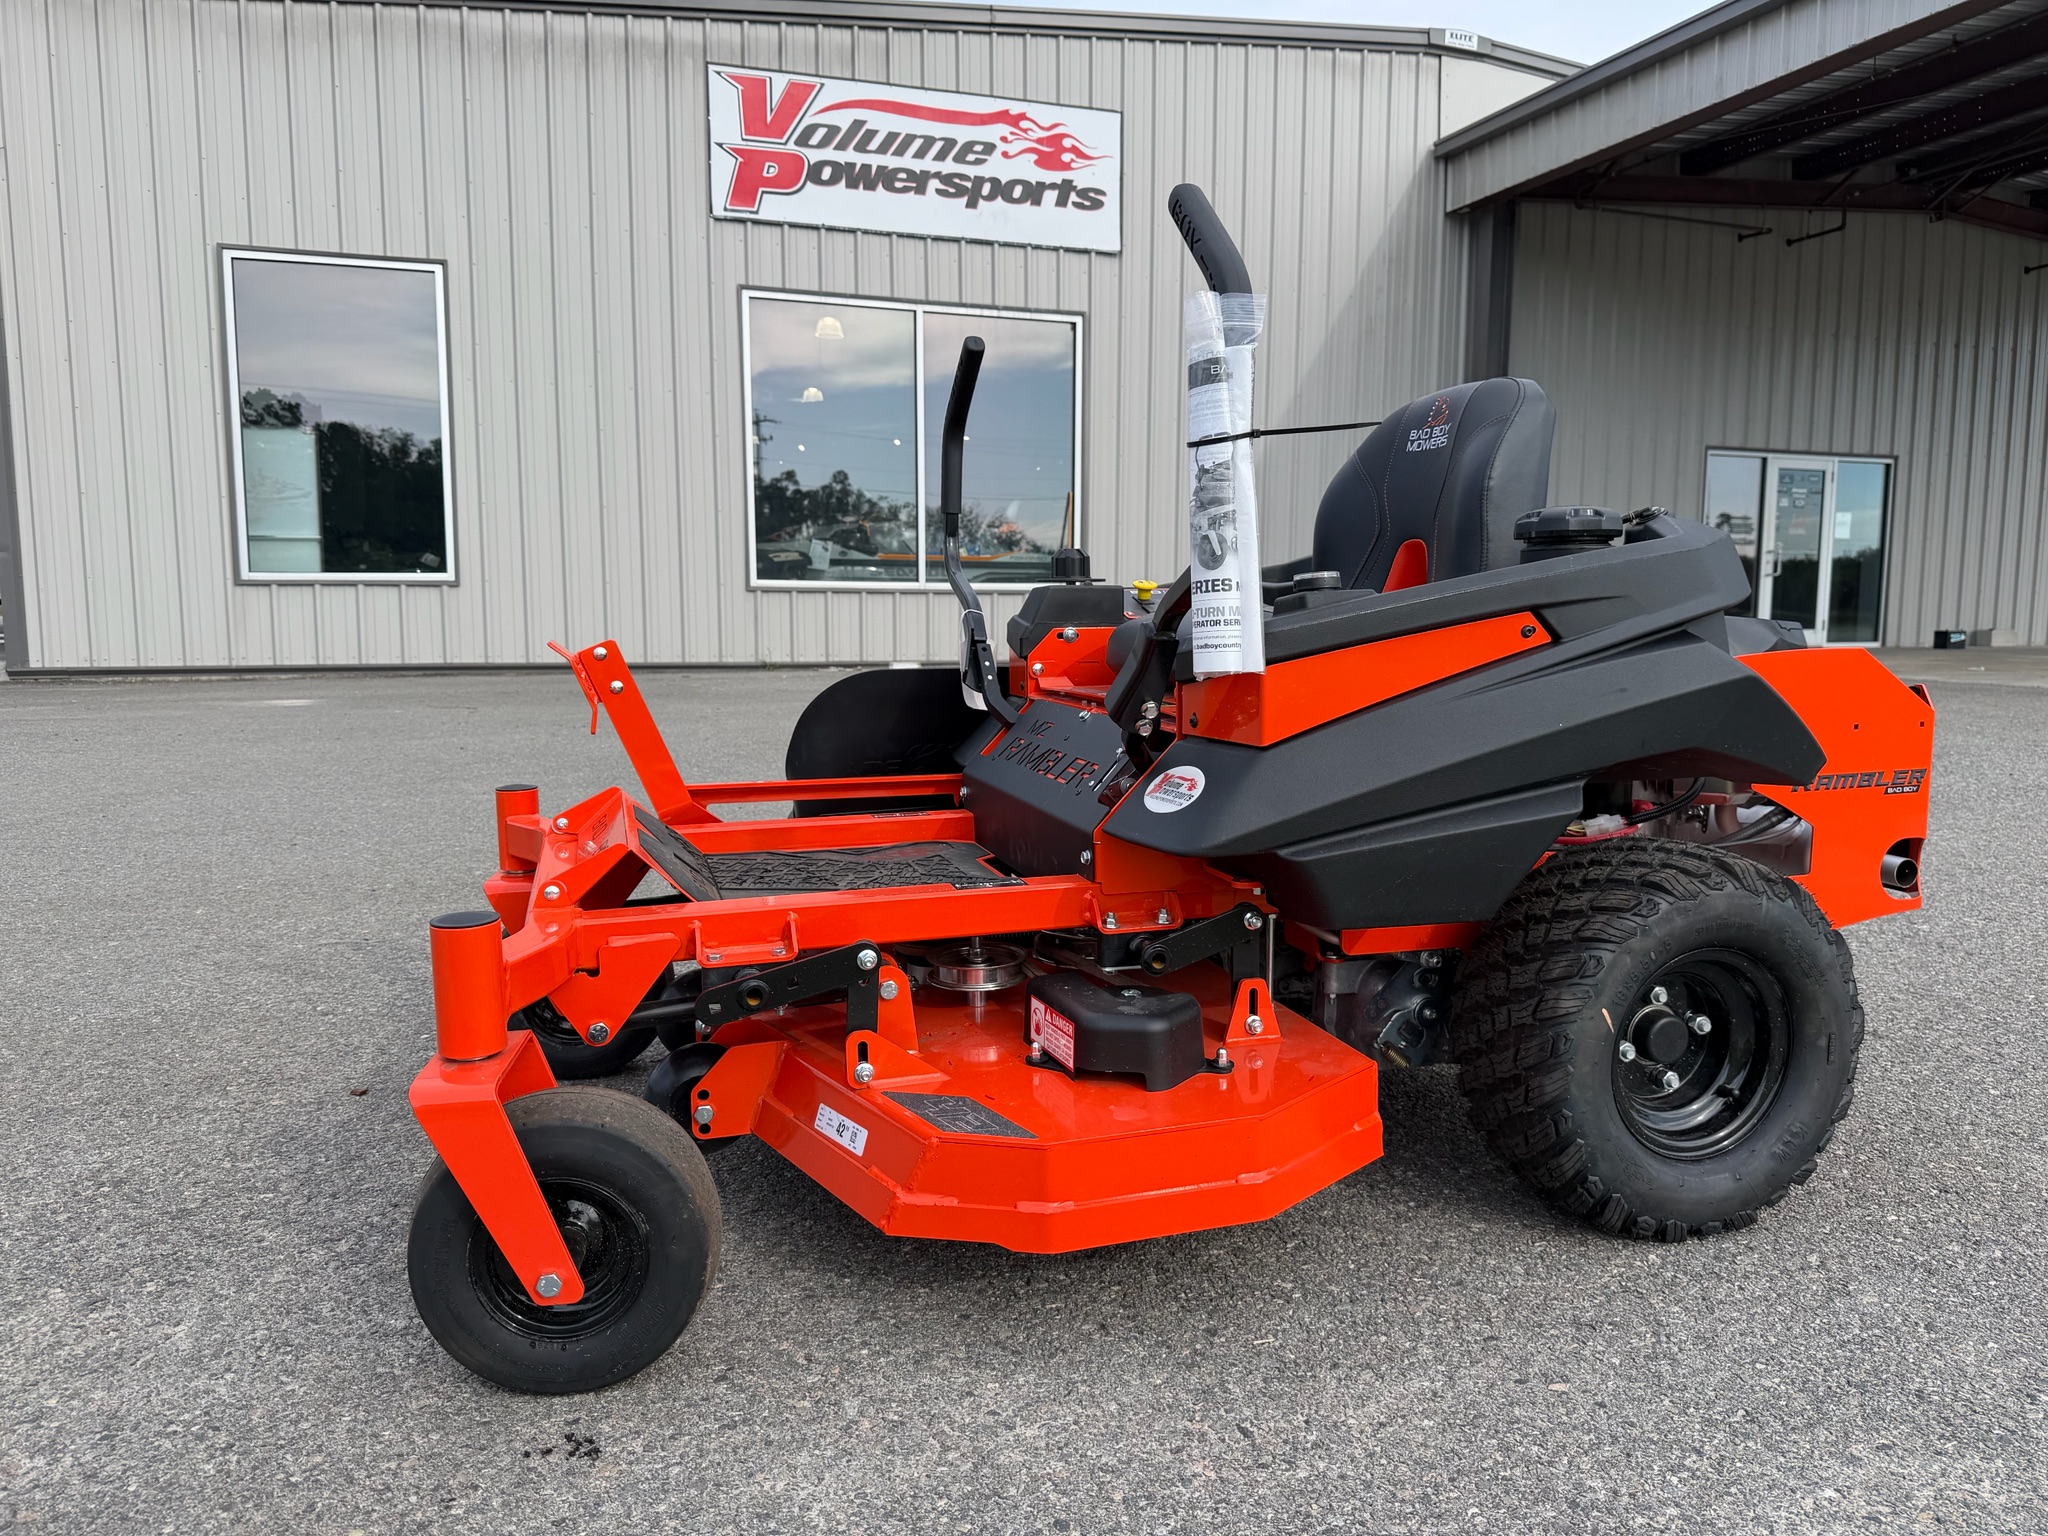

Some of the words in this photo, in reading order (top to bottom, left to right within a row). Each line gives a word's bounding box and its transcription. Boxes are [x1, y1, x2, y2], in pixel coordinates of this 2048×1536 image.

[1450, 32, 1474, 42] ELITE
[714, 70, 998, 166] Volume
[714, 142, 1107, 213] Powersports
[1409, 428, 1430, 440] BAD
[1432, 423, 1452, 437] BOY
[1406, 435, 1449, 452] MOWERS
[1193, 619, 1221, 629] ERATOR
[1027, 719, 1055, 738] MZ
[998, 736, 1100, 789] RAMBLER
[1052, 1013, 1073, 1037] DANGER
[836, 1122, 846, 1138] 42
